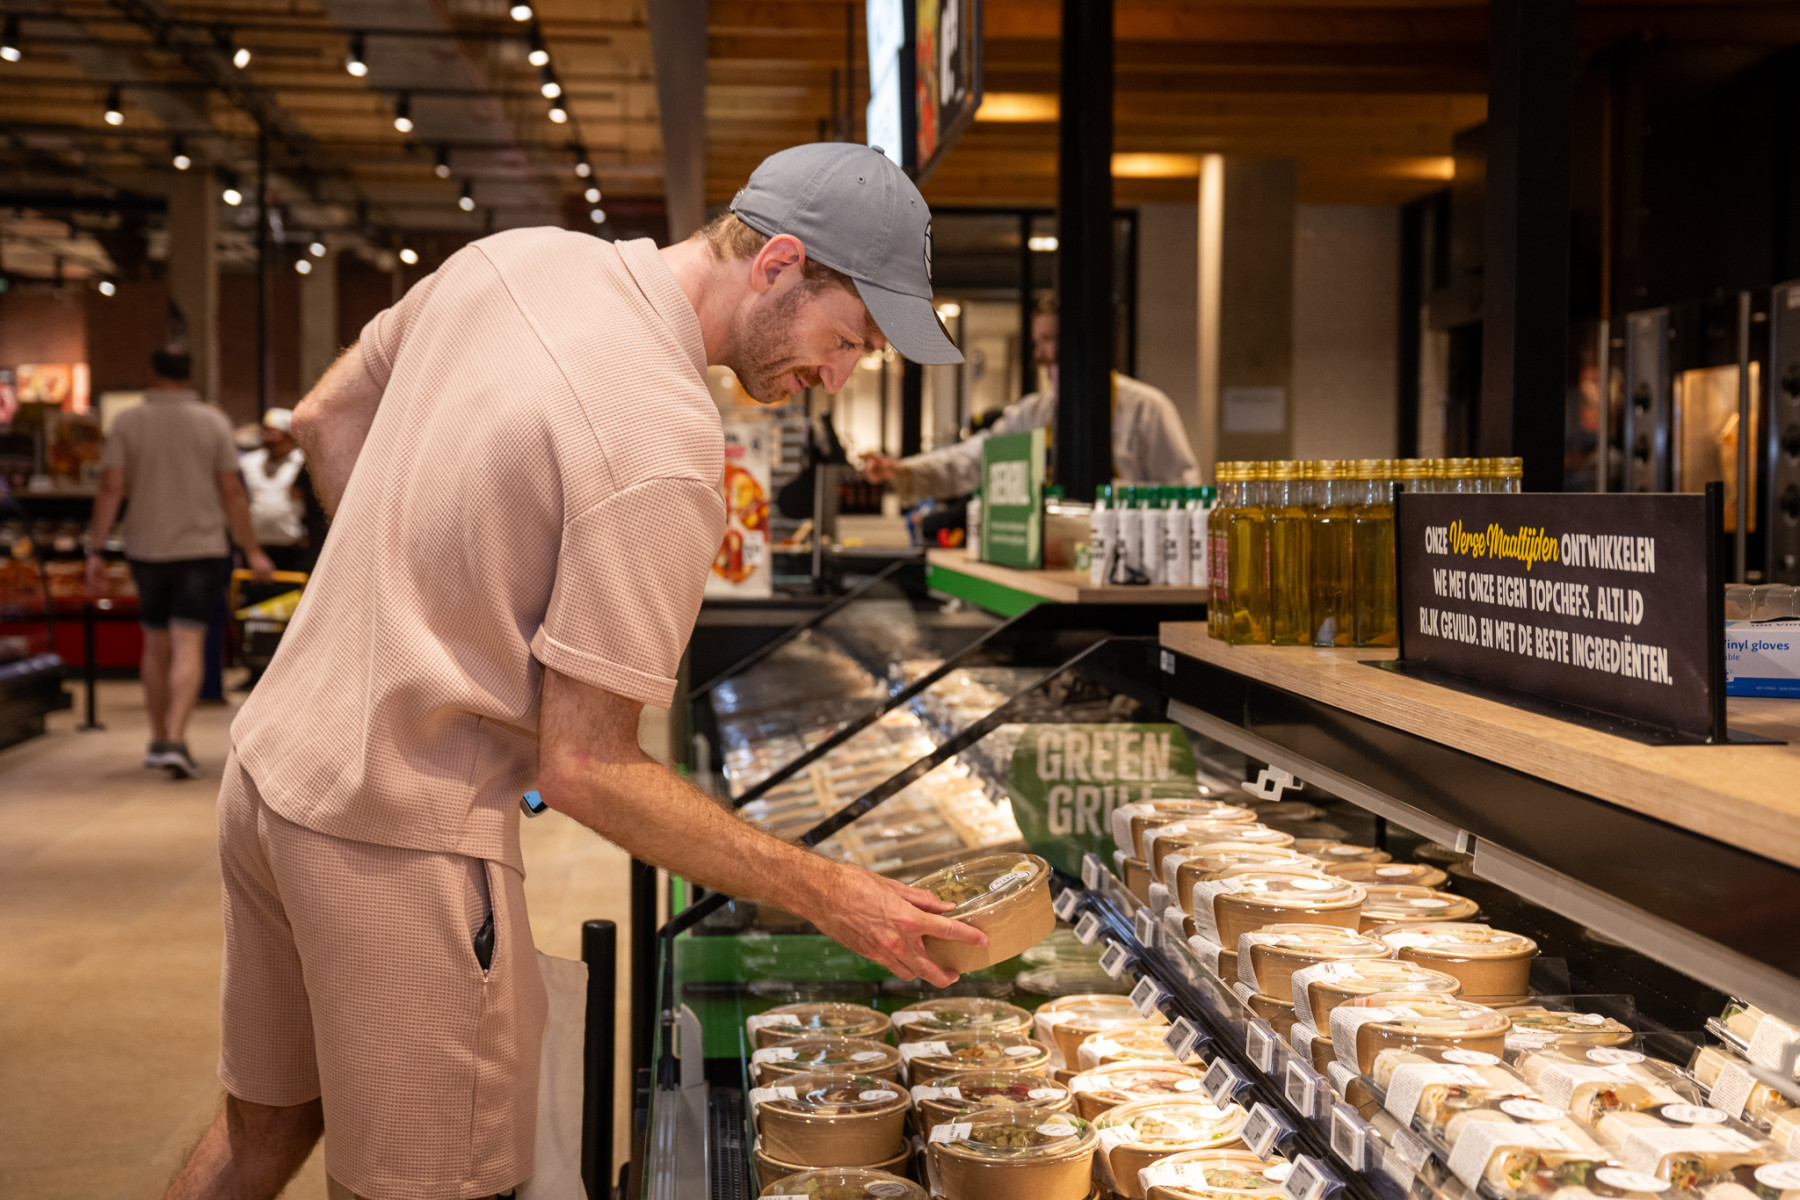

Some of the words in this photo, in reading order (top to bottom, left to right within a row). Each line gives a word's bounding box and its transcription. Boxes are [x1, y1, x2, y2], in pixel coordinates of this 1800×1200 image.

[1425, 526, 1448, 555] ONZE
[1449, 519, 1486, 559] Verse
[1486, 522, 1559, 571] Maaltijden
[1561, 533, 1655, 573] ONTWIKKELEN
[1433, 567, 1448, 597] WE
[1449, 569, 1466, 600] MET
[1469, 572, 1495, 604] ONZE
[1497, 575, 1527, 609] EIGEN
[1529, 579, 1594, 619] TOPCHEFS.
[1597, 586, 1644, 626] ALTIJD
[1420, 606, 1439, 637] RIJK
[1441, 610, 1479, 645] GEVULD.
[1481, 617, 1493, 648] EN
[1495, 619, 1515, 653] MET
[1518, 623, 1533, 657] DE
[1535, 626, 1569, 664] BESTE
[1572, 634, 1673, 686] INGREDIËNTEN.
[1726, 639, 1748, 652] inyl
[1751, 640, 1790, 652] gloves
[1036, 731, 1171, 782] GREEN
[1048, 784, 1154, 836] GRI
